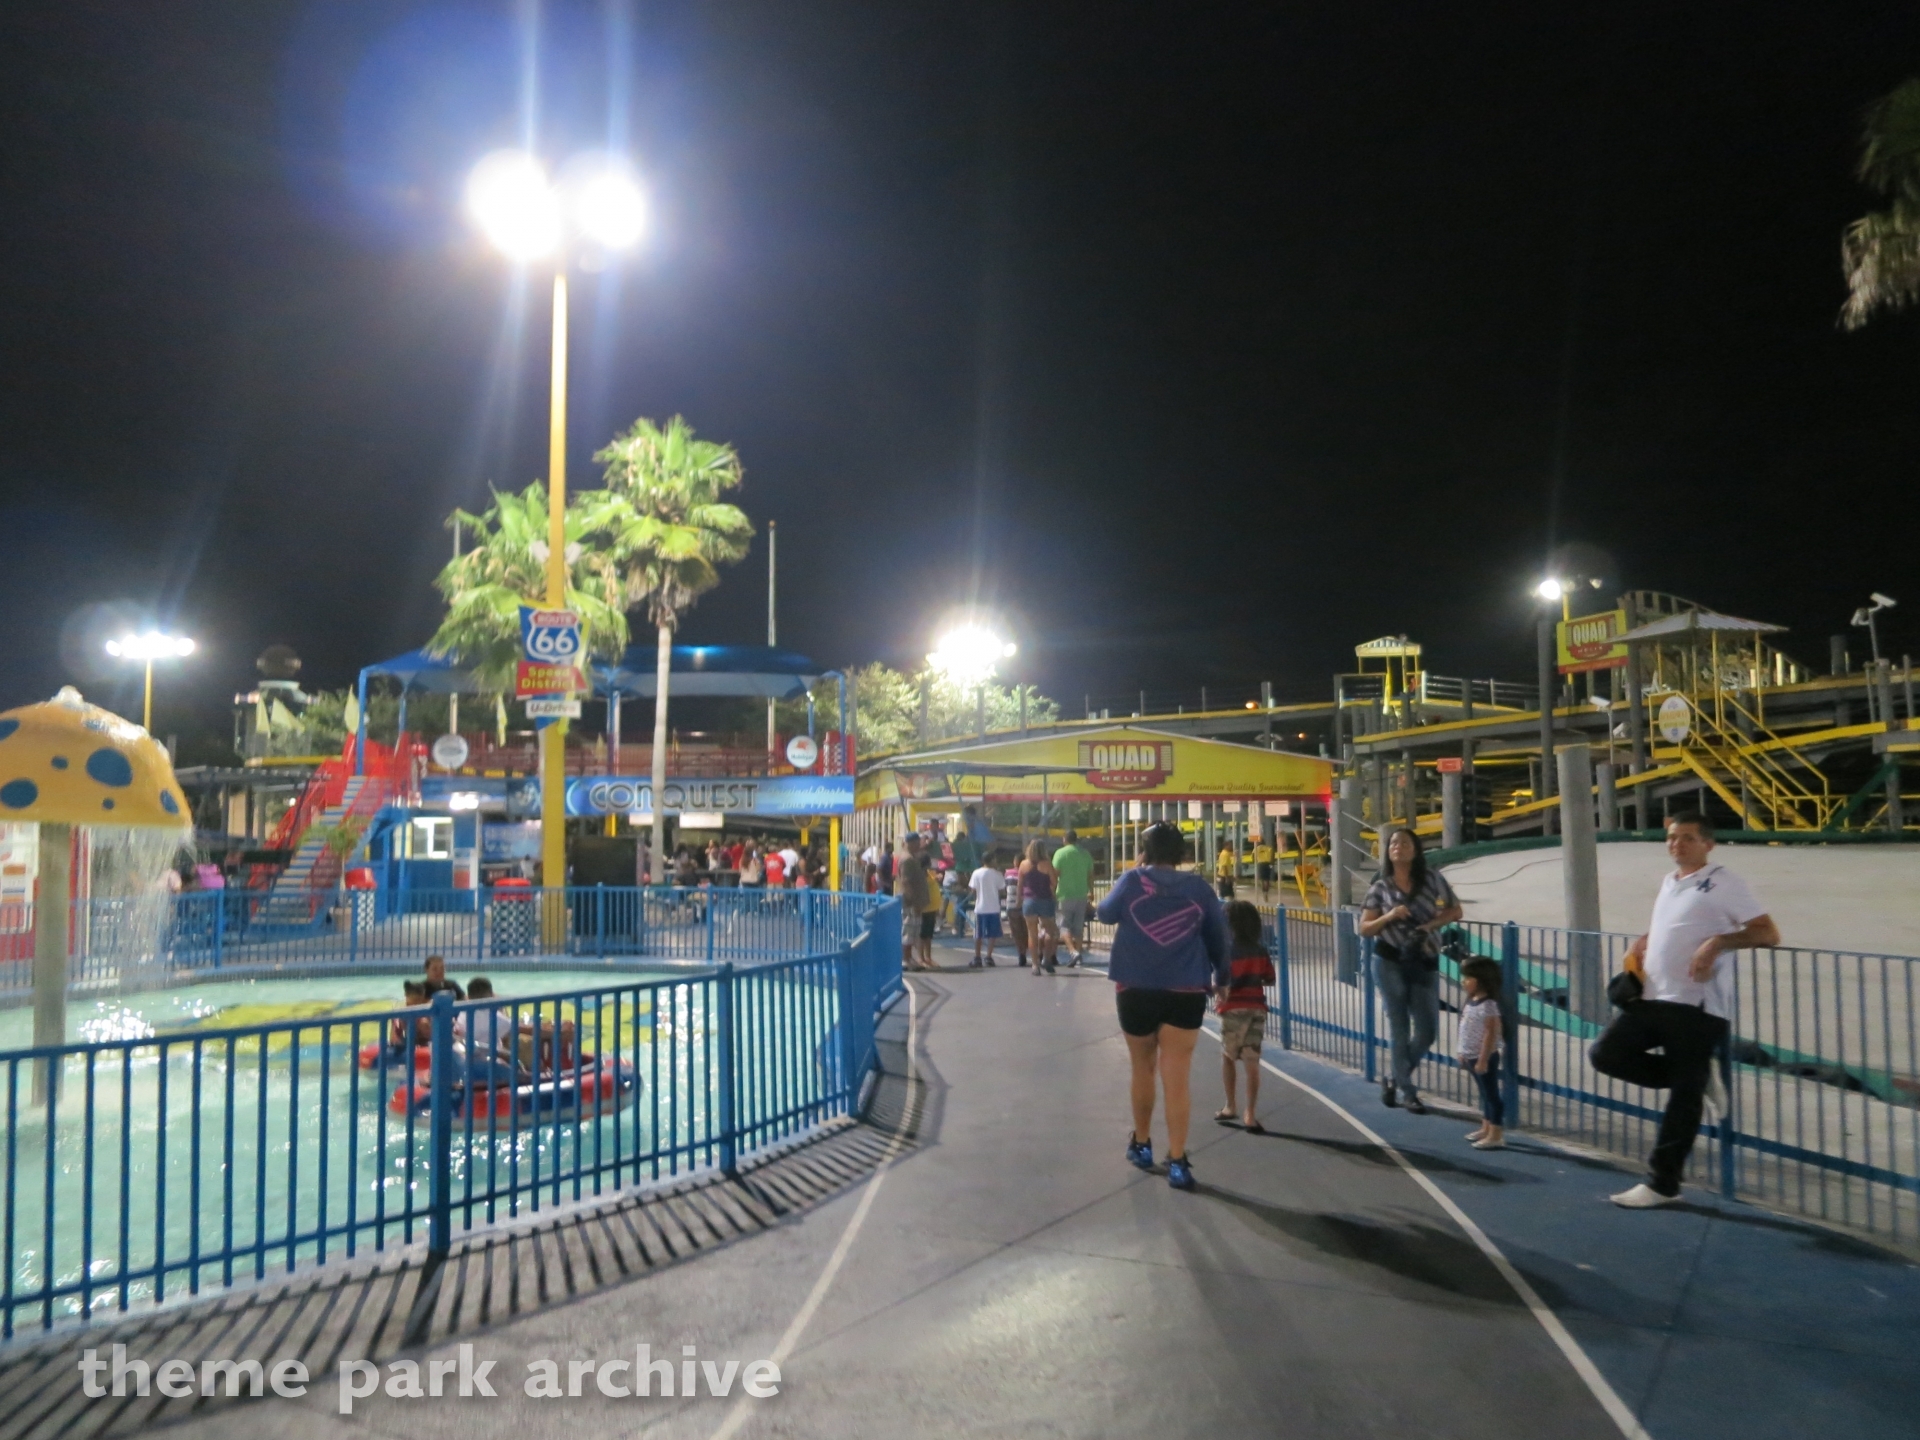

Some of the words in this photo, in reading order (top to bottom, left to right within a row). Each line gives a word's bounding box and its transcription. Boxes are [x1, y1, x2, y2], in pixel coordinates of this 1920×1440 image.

[535, 628, 574, 654] 66
[1573, 621, 1606, 646] QUAD
[528, 666, 570, 678] Speed
[521, 678, 575, 689] District
[1093, 745, 1156, 773] QUAD
[966, 781, 994, 791] Desgn
